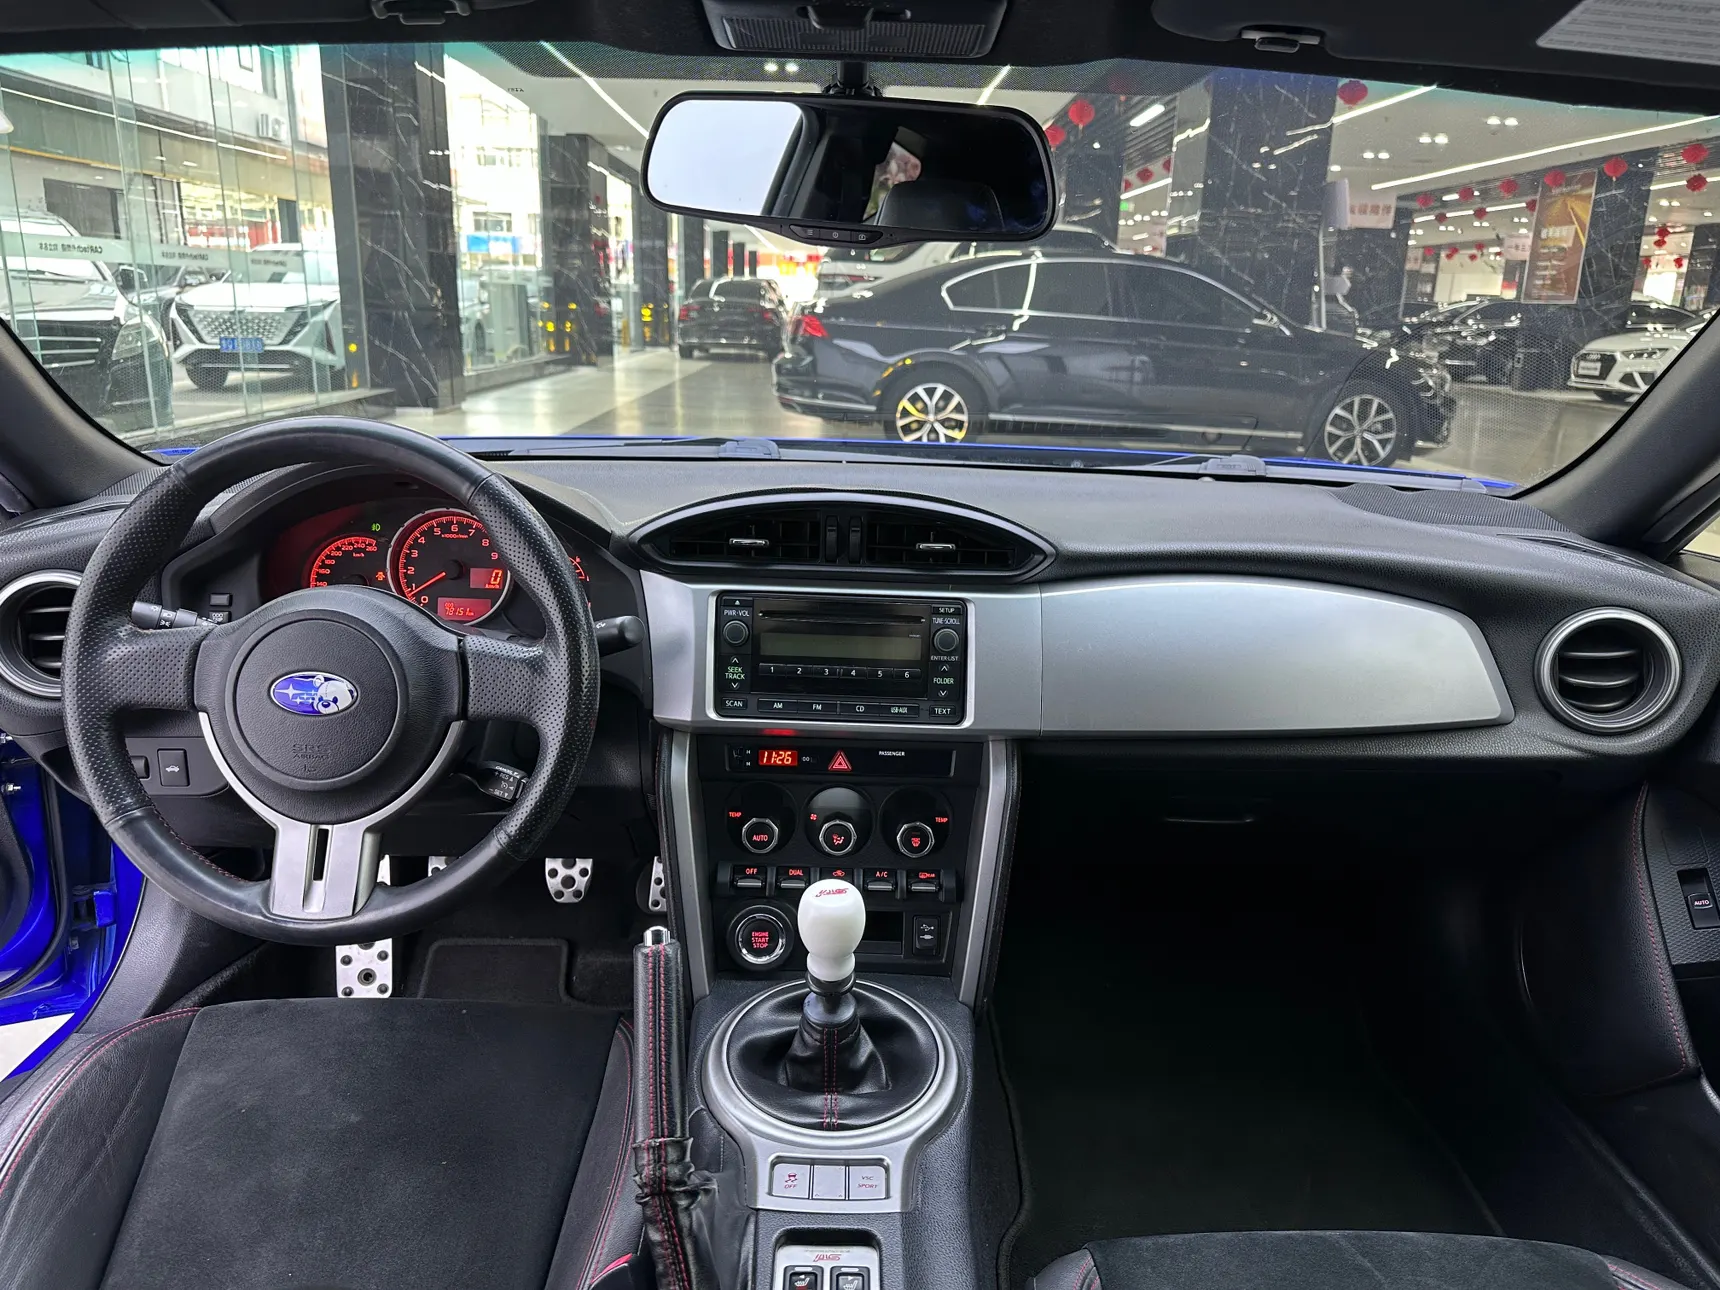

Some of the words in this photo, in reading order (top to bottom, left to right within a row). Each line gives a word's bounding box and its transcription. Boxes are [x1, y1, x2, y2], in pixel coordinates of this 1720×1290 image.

[482, 538, 490, 546] 8
[490, 569, 502, 584] 0
[763, 751, 792, 764] 11:26
